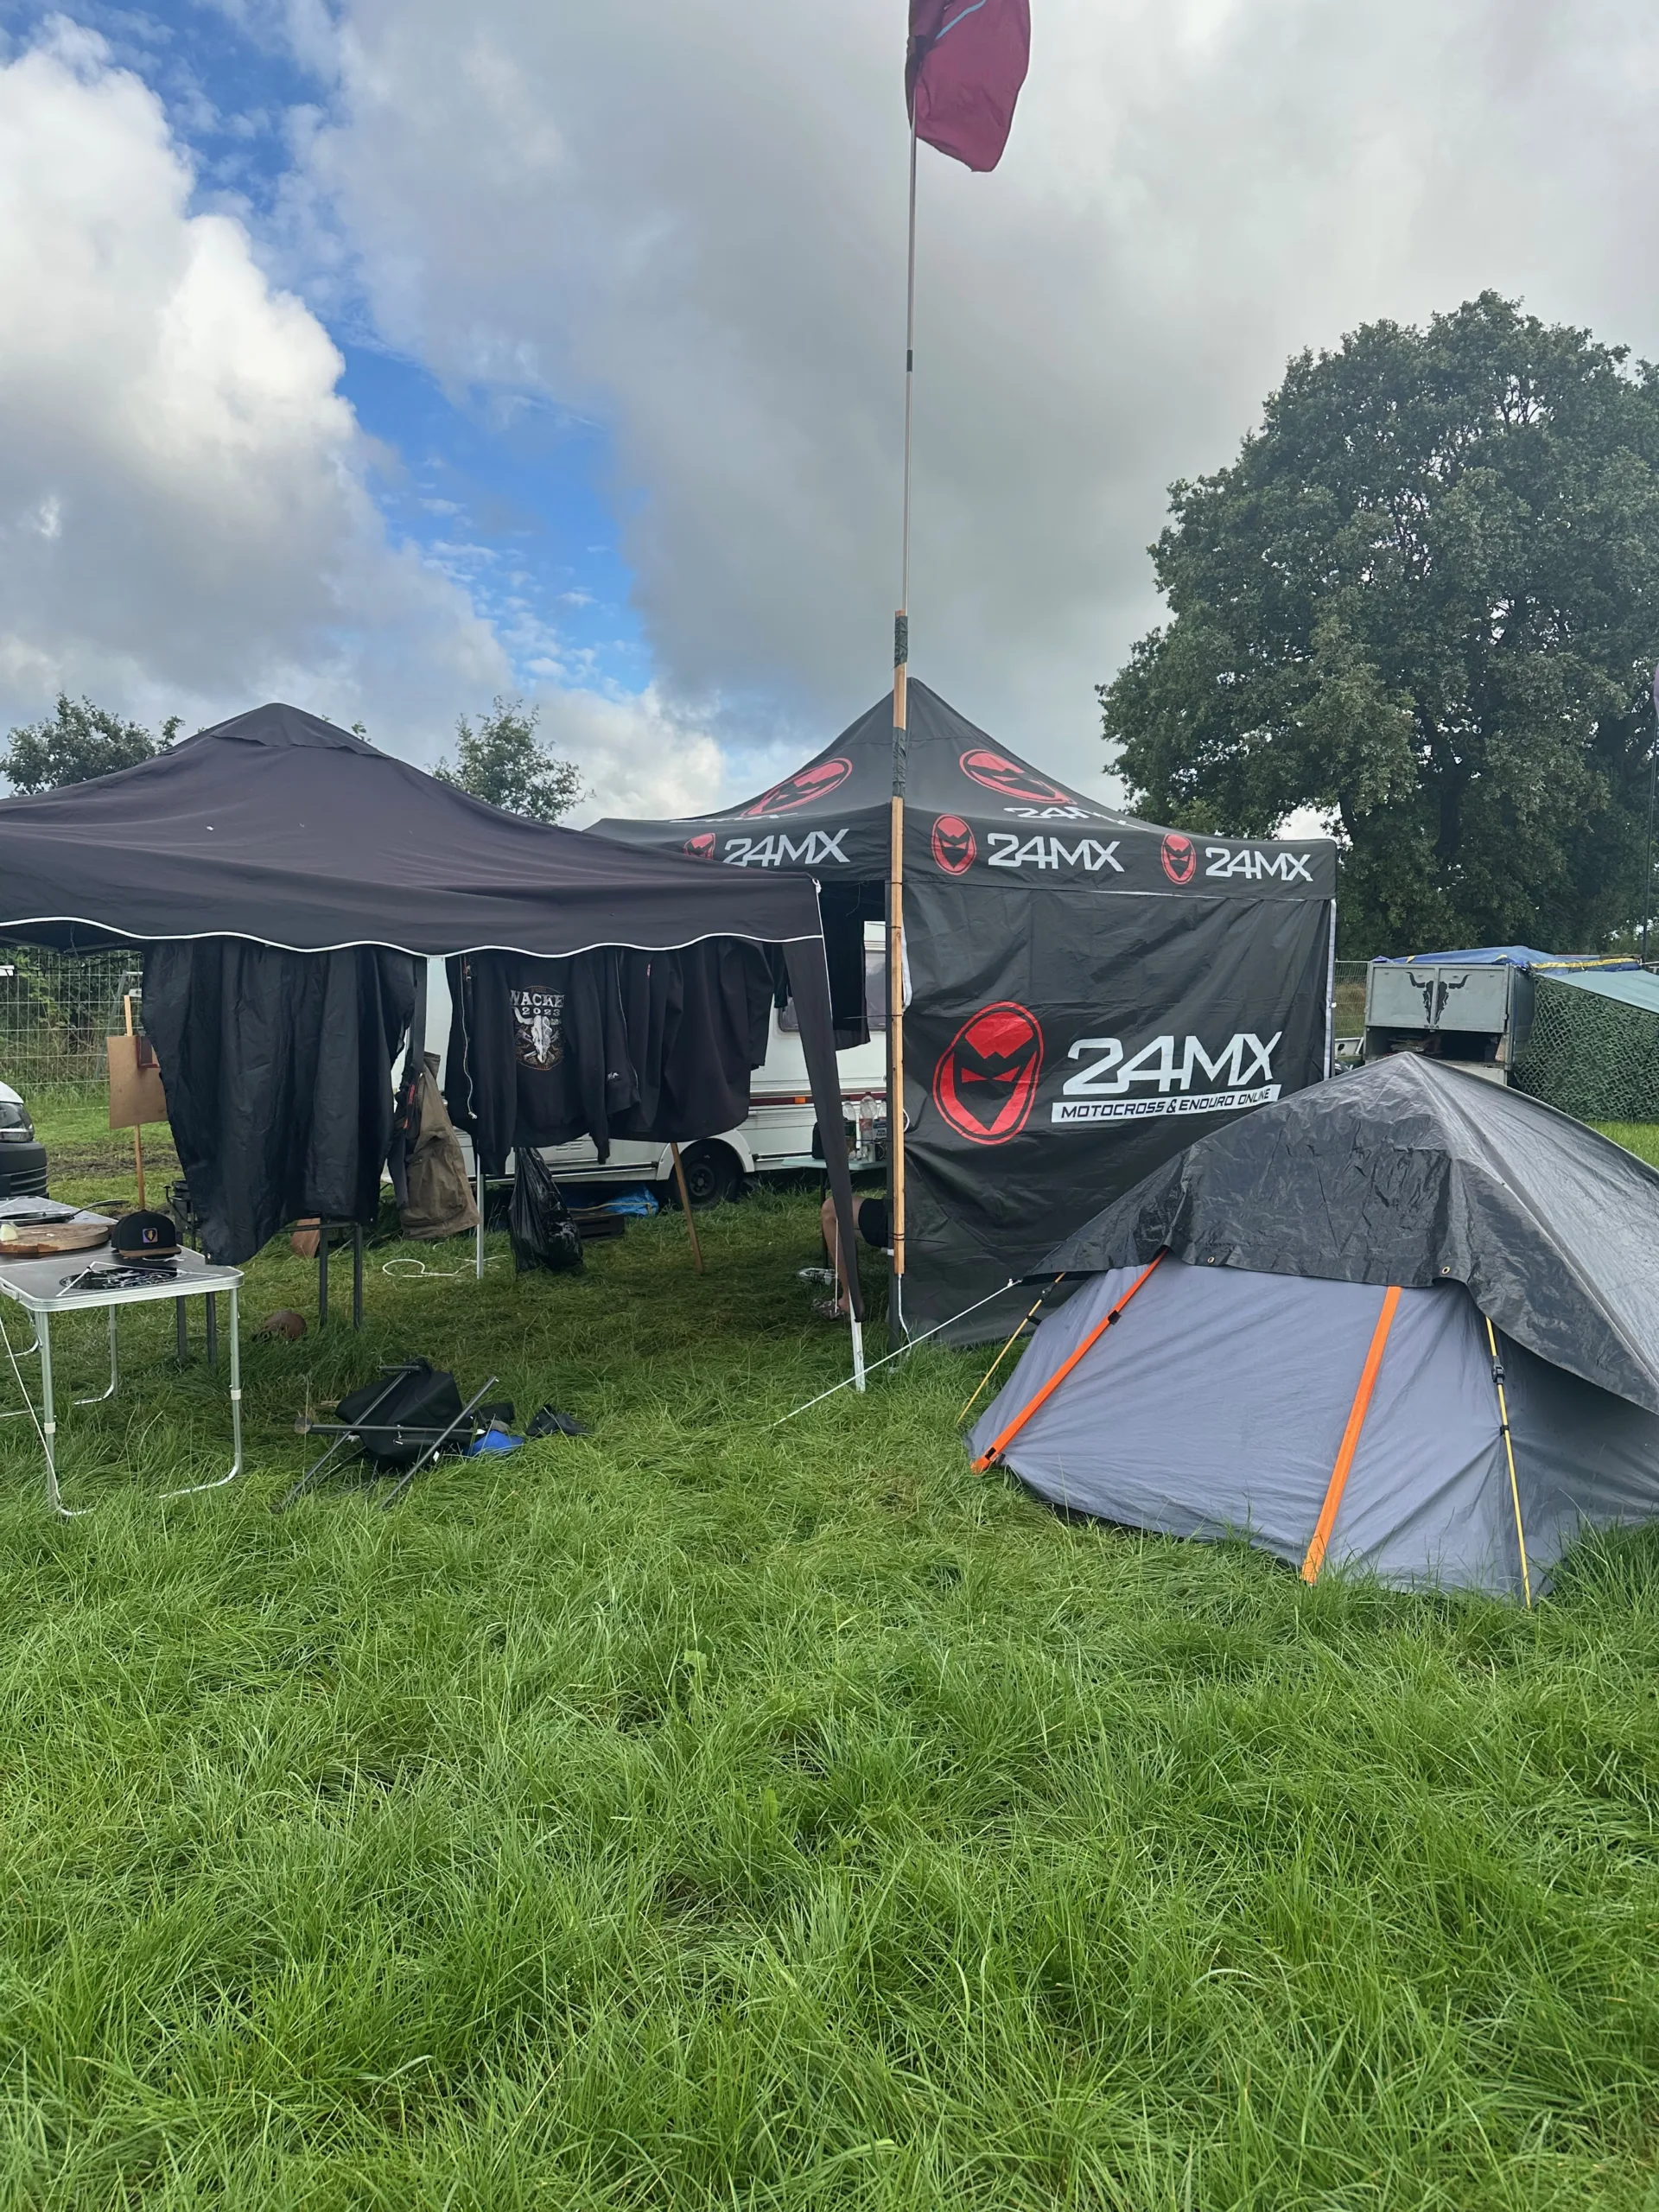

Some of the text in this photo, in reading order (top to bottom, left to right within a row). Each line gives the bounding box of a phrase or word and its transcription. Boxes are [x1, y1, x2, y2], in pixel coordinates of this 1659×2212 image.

[723, 828, 850, 868] 24MX
[988, 833, 1125, 873] 24MX
[1205, 847, 1314, 882] 24MX
[522, 1007, 560, 1016] 2023
[1063, 1031, 1282, 1095] 24MX
[1061, 1088, 1271, 1119] MOTOCROSS & ENDURO ONLINE
